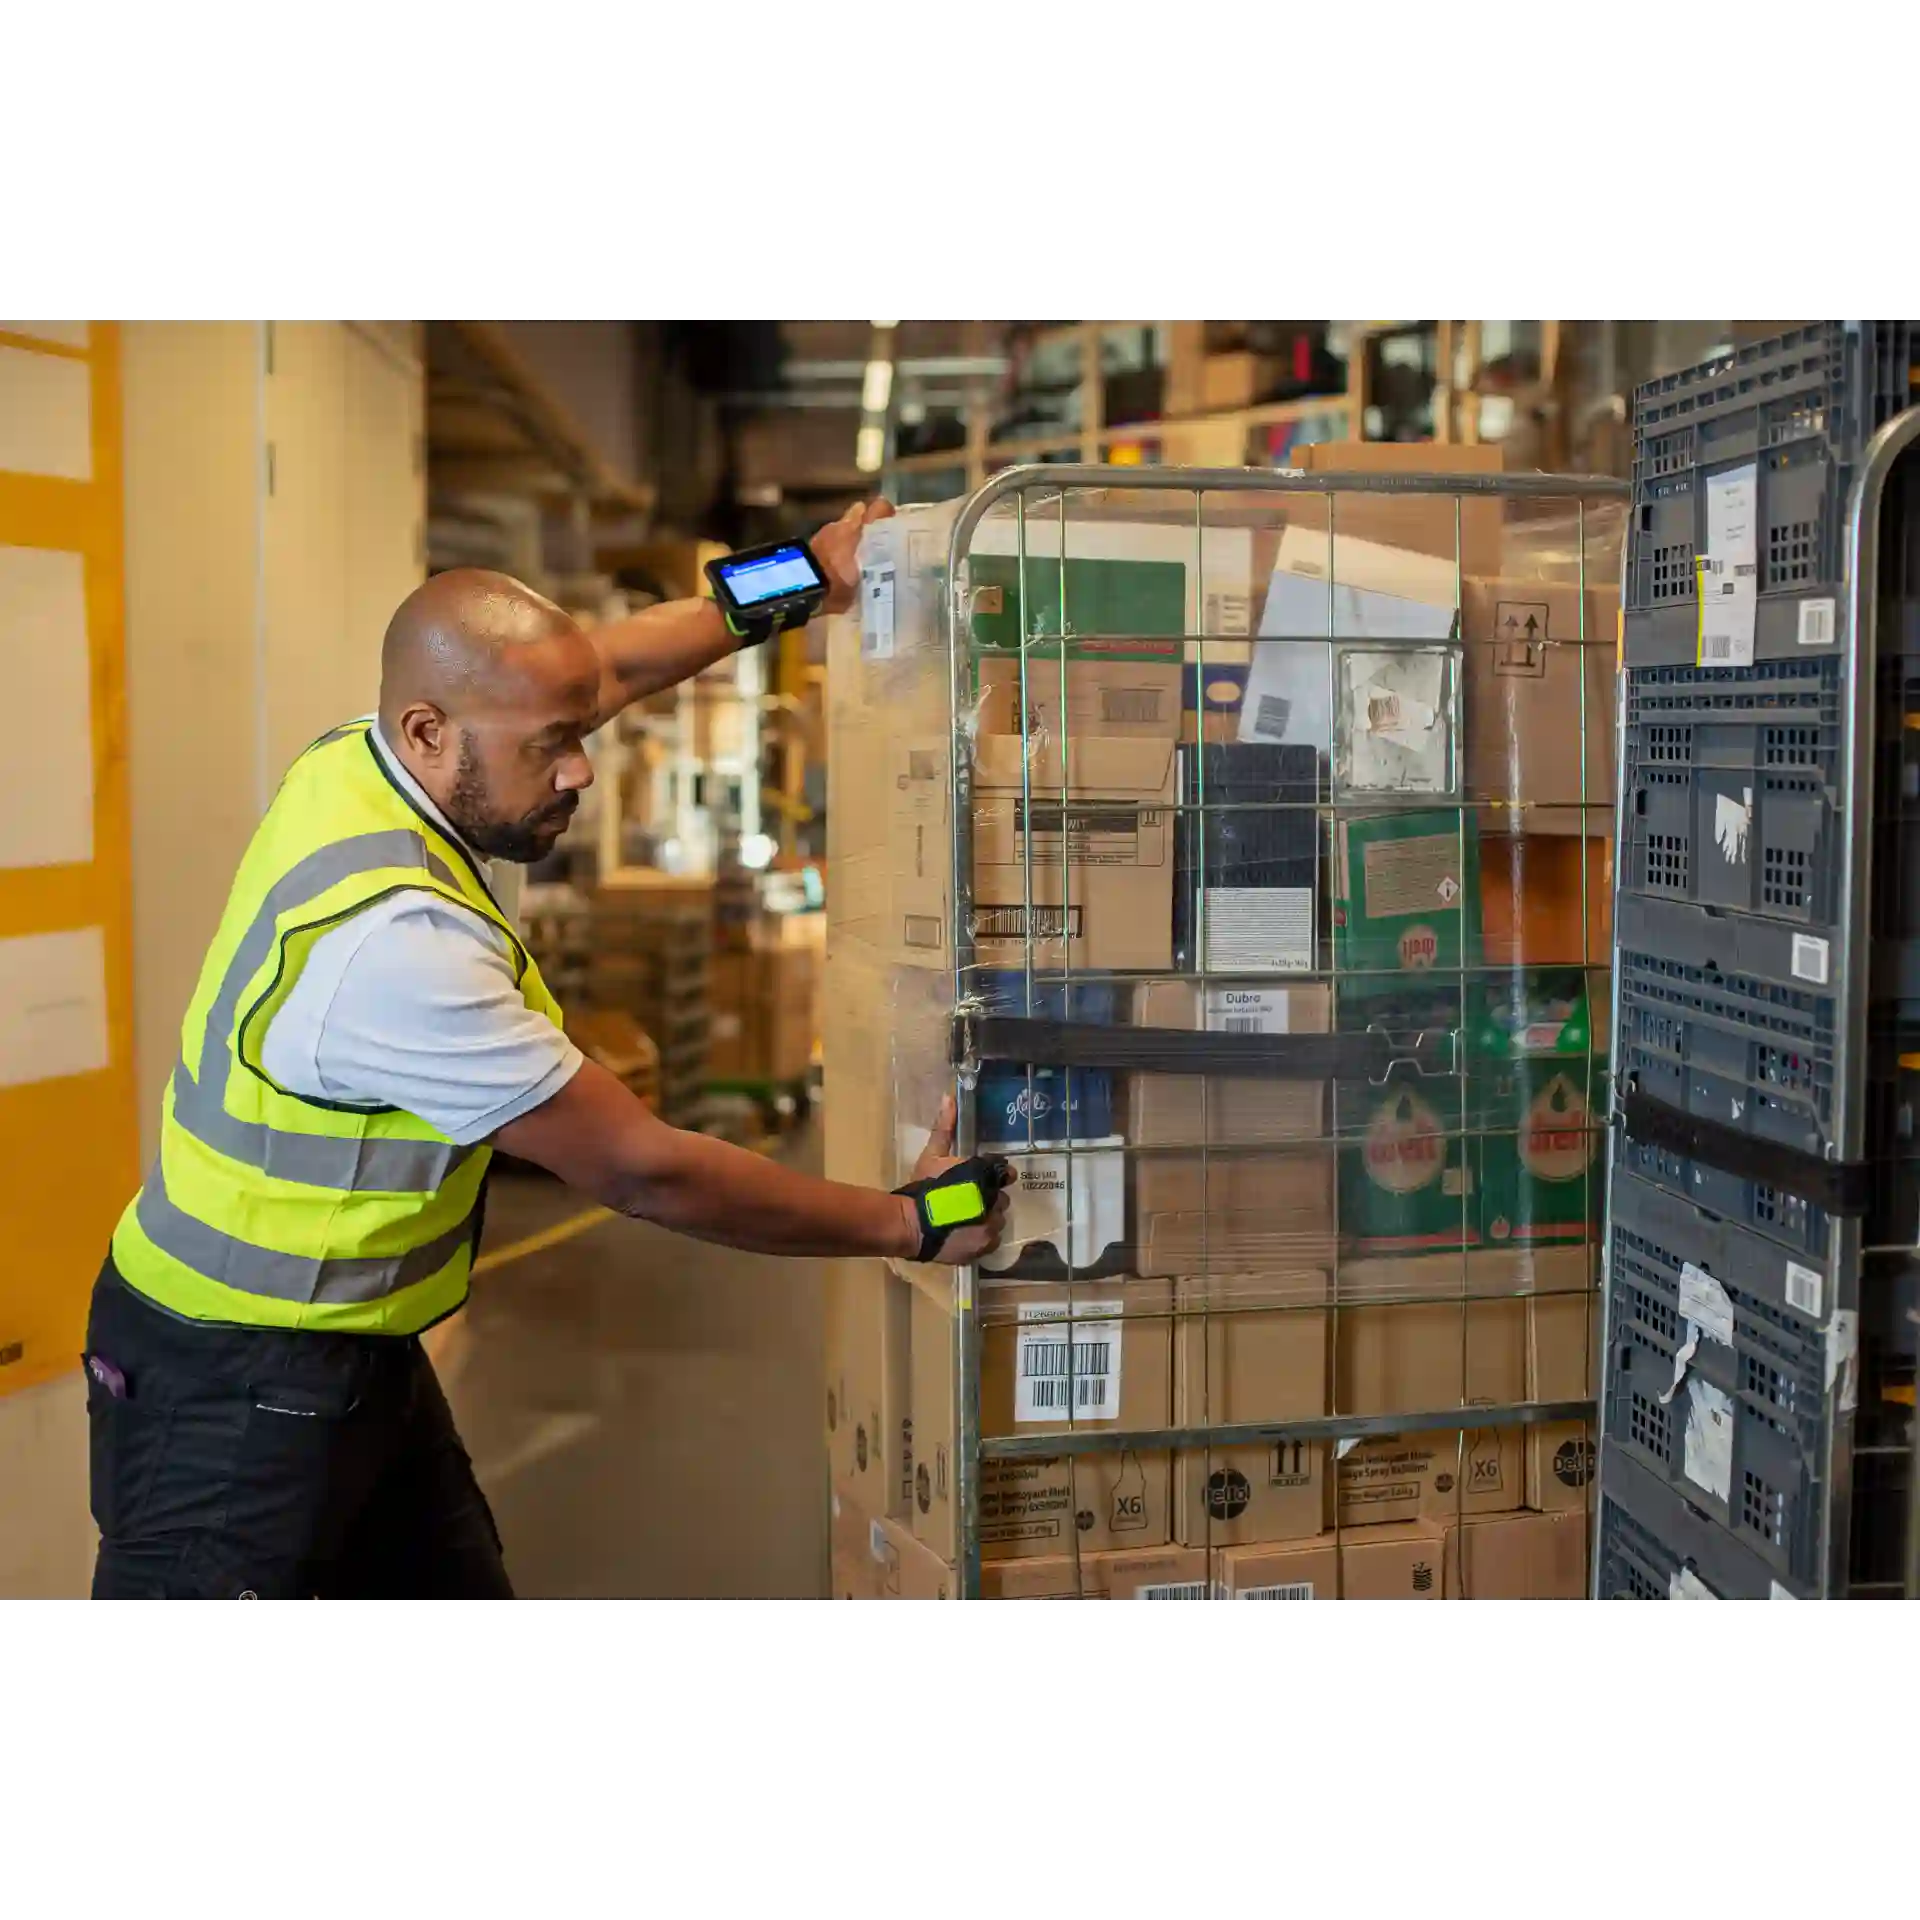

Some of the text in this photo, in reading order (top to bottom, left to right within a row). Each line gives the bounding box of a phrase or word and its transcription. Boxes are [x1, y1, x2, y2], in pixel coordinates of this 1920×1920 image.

[1226, 992, 1262, 1004] Dubro
[1475, 1459, 1497, 1478] X6
[1117, 1496, 1141, 1515] X6
